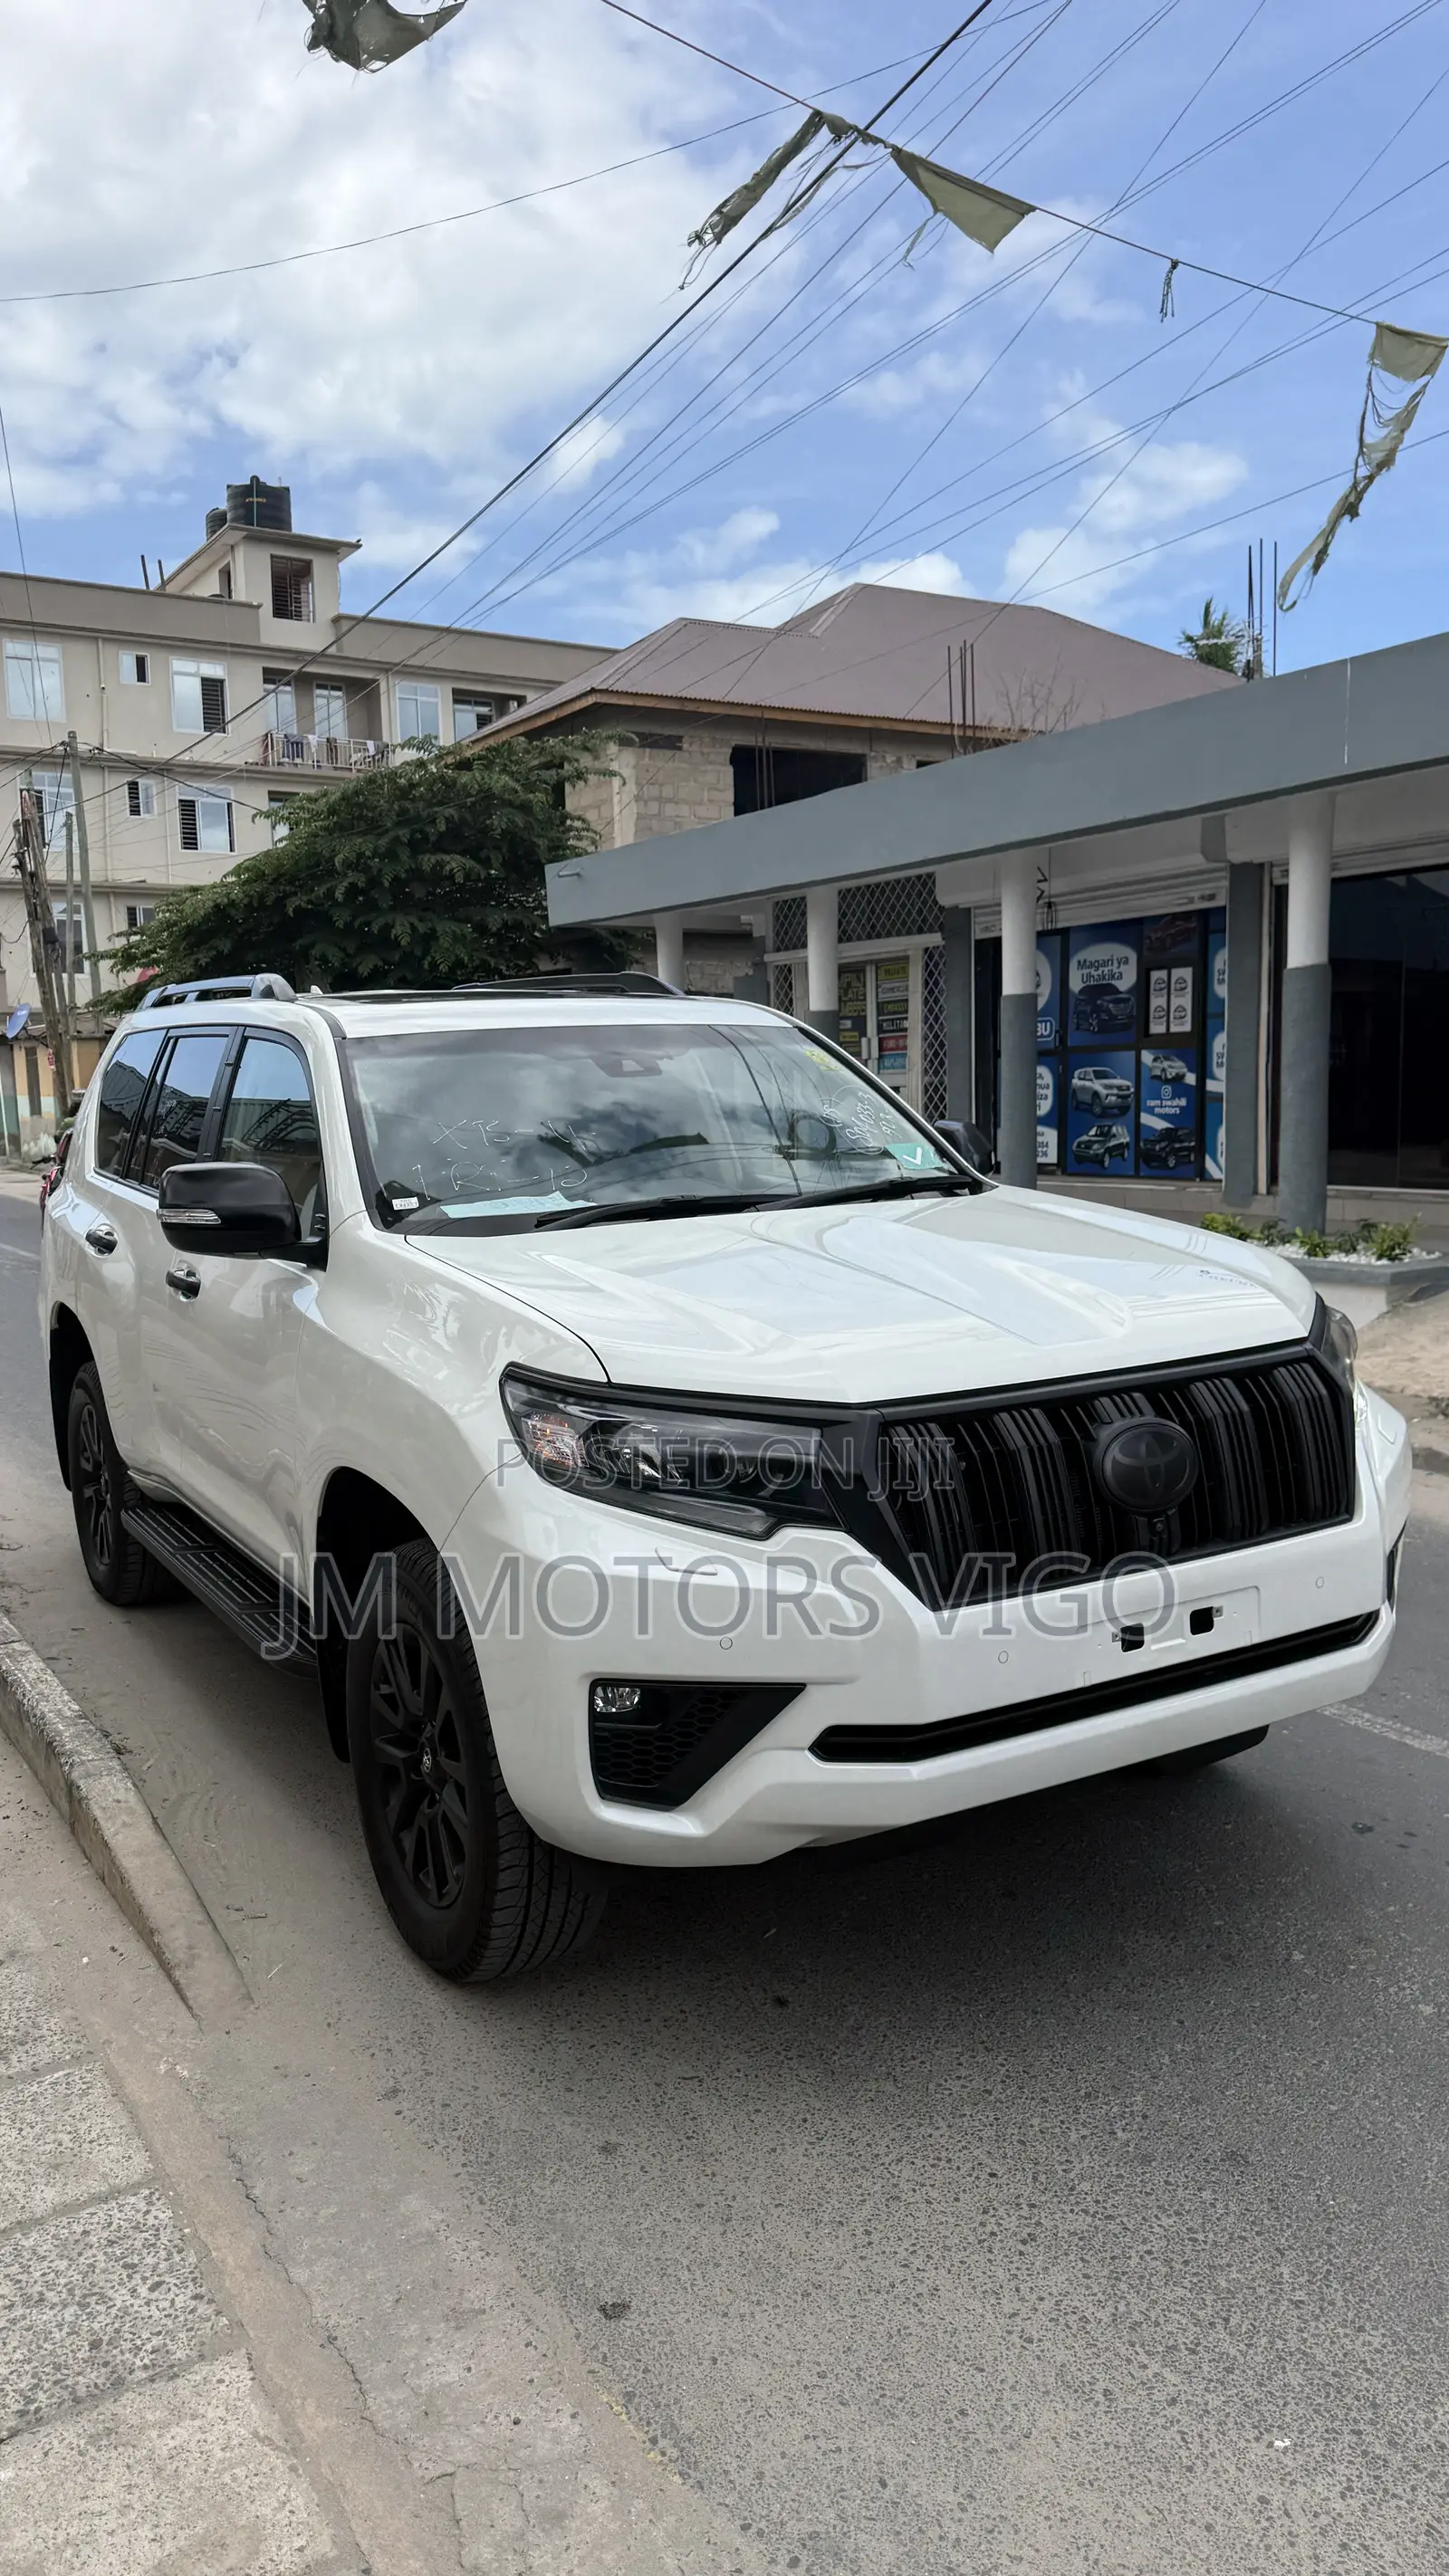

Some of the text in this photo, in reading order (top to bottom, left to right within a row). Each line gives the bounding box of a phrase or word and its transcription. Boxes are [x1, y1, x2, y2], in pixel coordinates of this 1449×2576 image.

[1077, 955, 1129, 972] Magari ya
[1081, 969, 1123, 984] Uhakika
[1162, 1097, 1187, 1106] swahili
